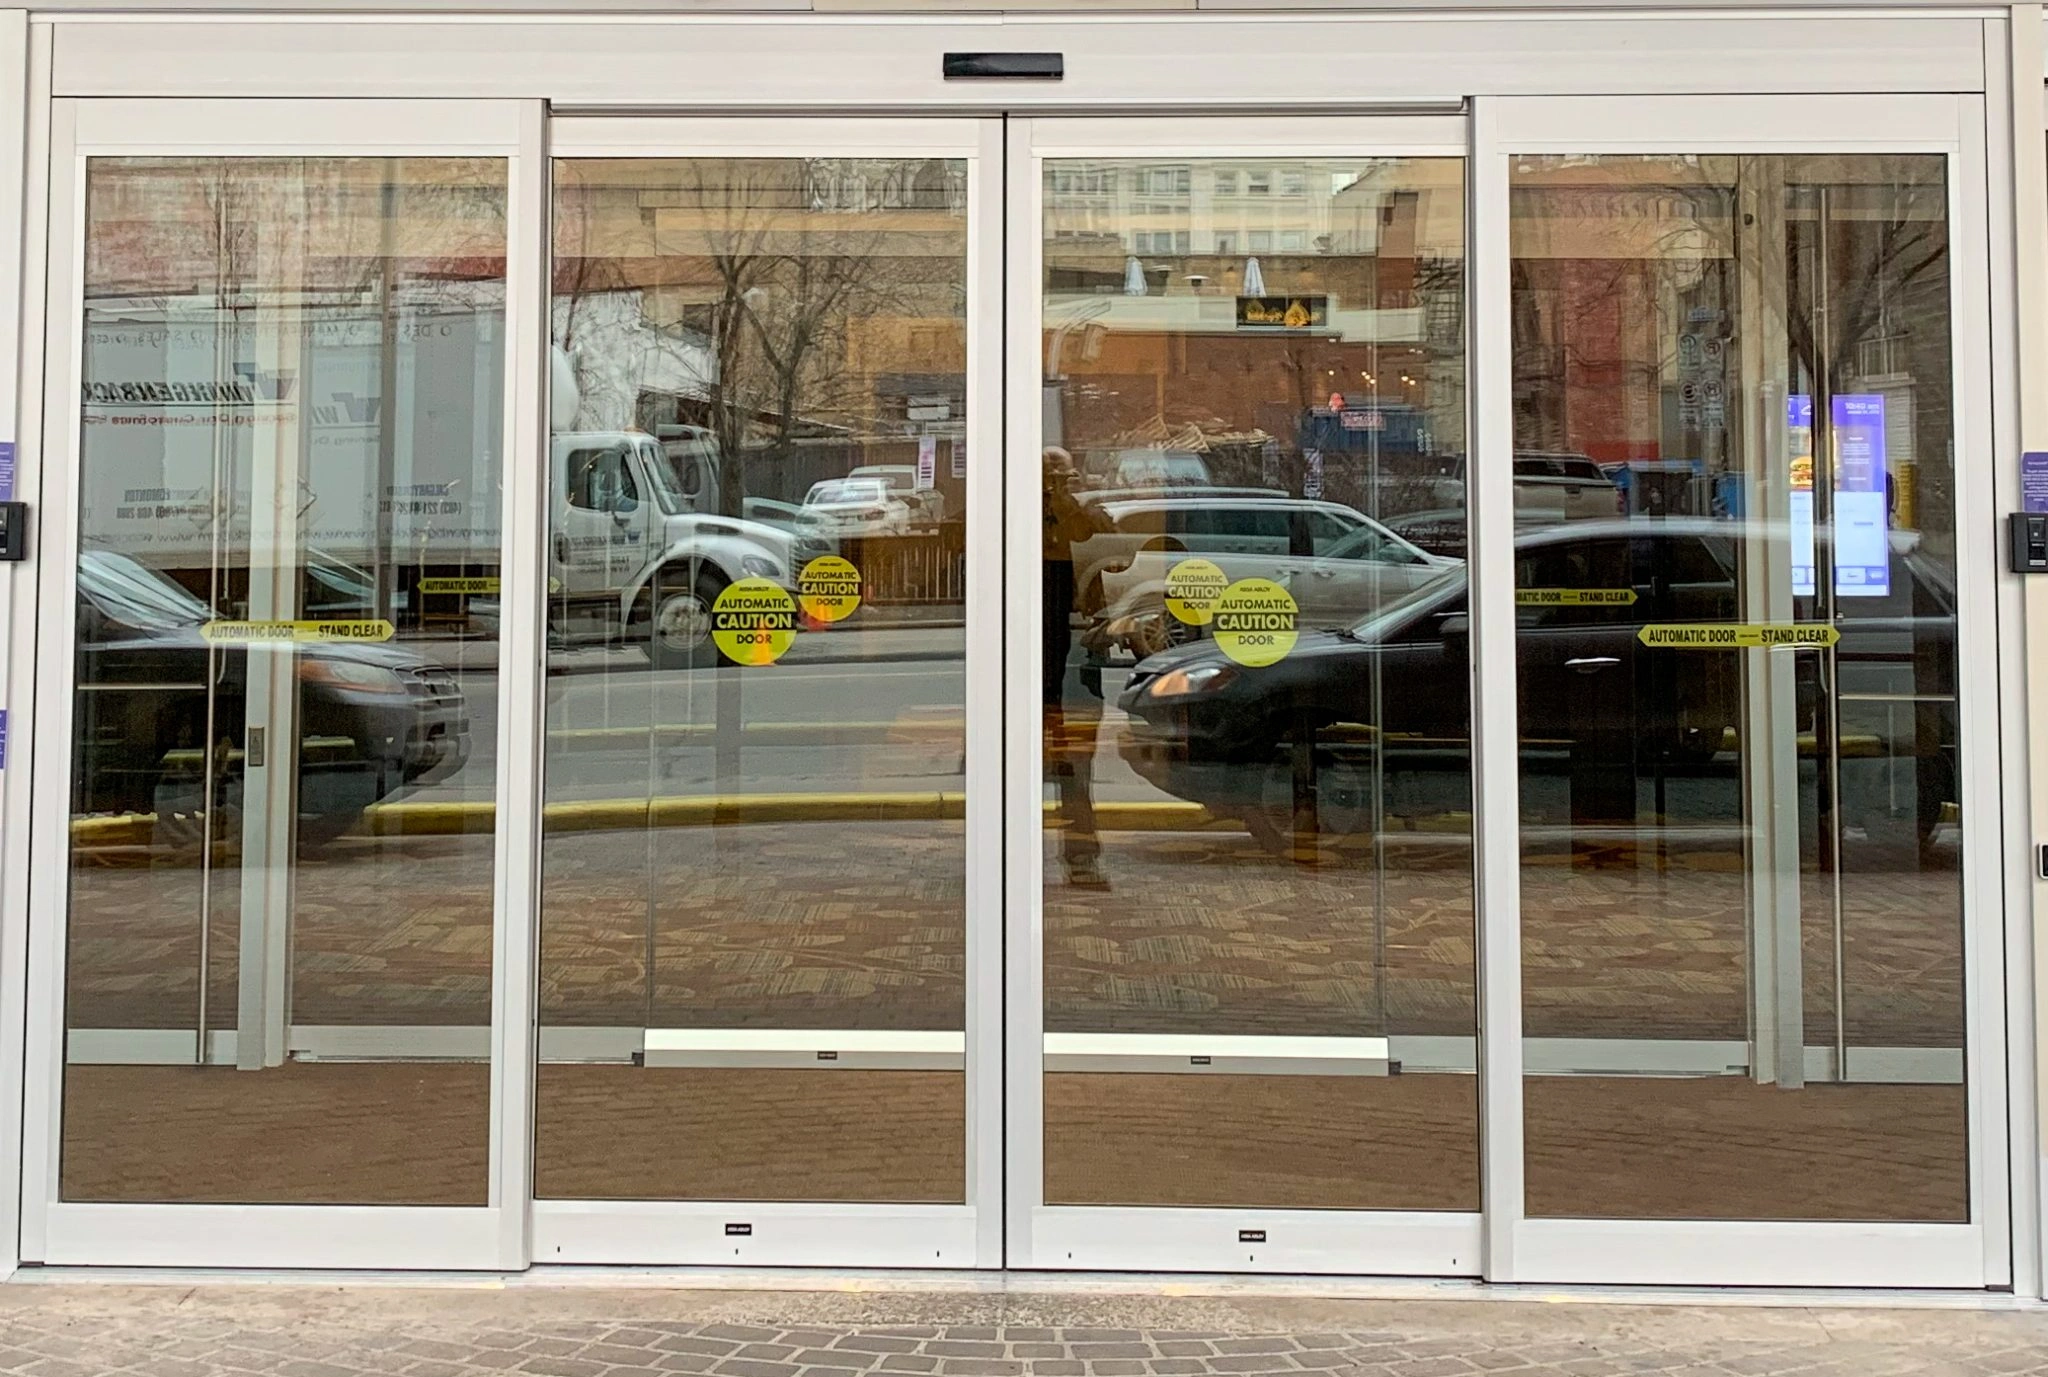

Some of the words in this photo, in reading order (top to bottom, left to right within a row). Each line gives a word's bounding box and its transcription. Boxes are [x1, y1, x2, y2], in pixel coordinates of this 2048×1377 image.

[805, 571, 857, 580] AUTOMATIC
[1171, 575, 1223, 583] AUTOMATIC
[424, 581, 466, 591] AUTOMATIC
[467, 581, 488, 590] DOOR
[801, 583, 859, 595] CAUTION
[1168, 586, 1225, 598] CAUTION
[1541, 592, 1562, 602] DOOR
[1580, 592, 1603, 602] STAND
[1605, 592, 1629, 602] CLEAR
[720, 598, 789, 609] AUTOMATIC
[816, 598, 843, 606] DOOR
[1183, 601, 1211, 610] DOOR
[1220, 599, 1291, 610] AUTOMATIC
[716, 613, 792, 629] CAUTION
[1217, 614, 1294, 630] CAUTION
[210, 625, 265, 638] AUTOMATIC
[267, 625, 294, 637] DOOR
[318, 625, 350, 637] STAND
[352, 624, 383, 637] CLEAR
[1649, 629, 1707, 643] AUTOMATIC
[1709, 629, 1736, 642] DOOR
[1761, 629, 1794, 643] STAND
[1796, 629, 1829, 643] CLEAR
[736, 633, 772, 644] DOOR
[1238, 635, 1275, 645] DOOR
